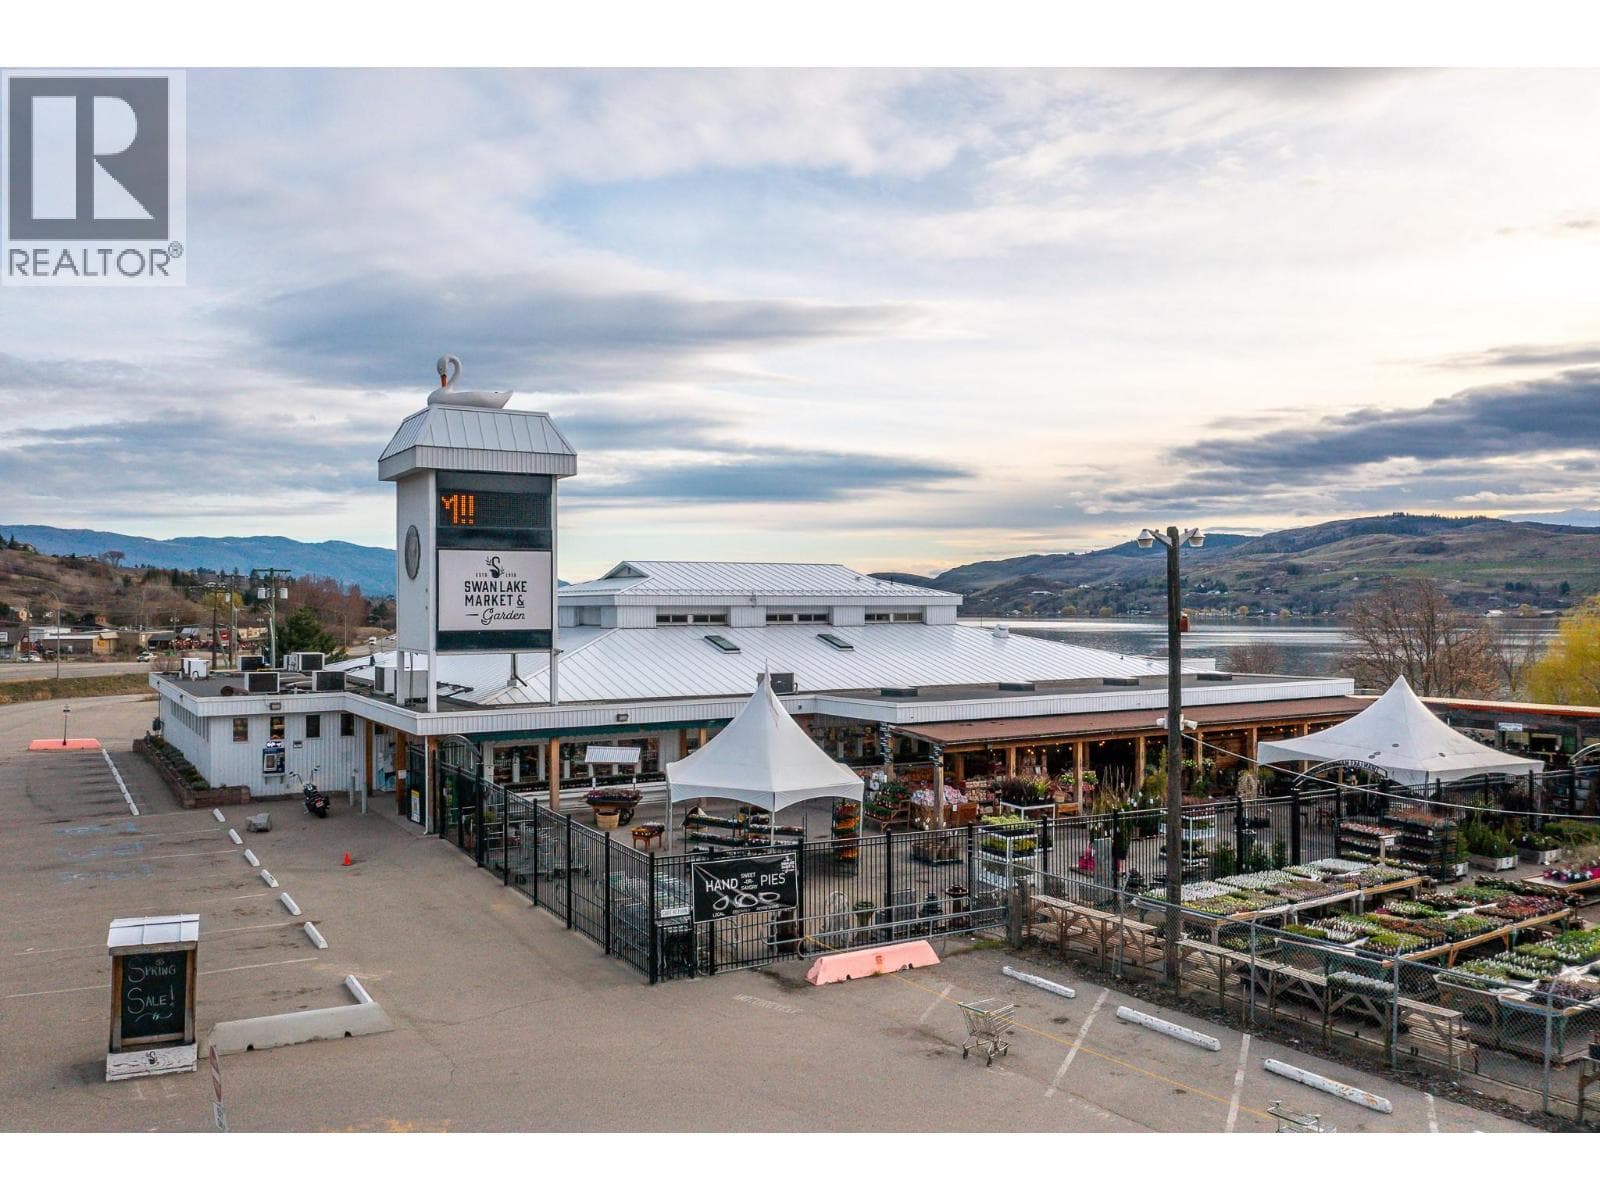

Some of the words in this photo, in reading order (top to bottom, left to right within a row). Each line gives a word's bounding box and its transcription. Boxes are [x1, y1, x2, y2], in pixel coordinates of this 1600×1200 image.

[464, 581, 497, 593] SWAN
[500, 581, 527, 593] LAKE
[465, 595, 513, 607] MARKET
[516, 594, 525, 609] &
[481, 608, 525, 625] Garden
[705, 878, 739, 893] HAND
[760, 872, 786, 887] PIES
